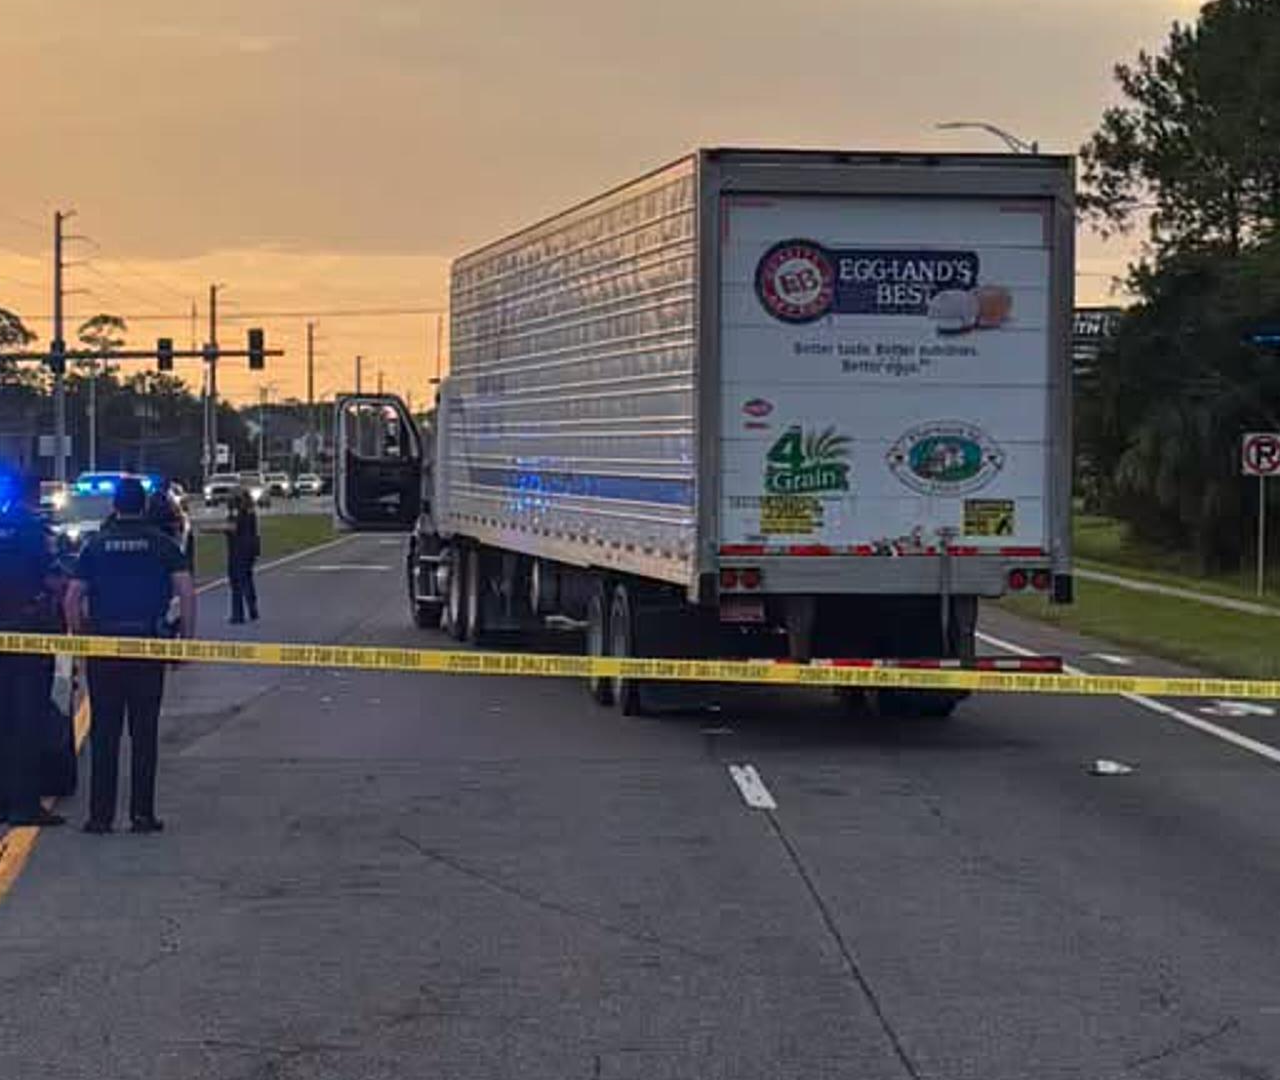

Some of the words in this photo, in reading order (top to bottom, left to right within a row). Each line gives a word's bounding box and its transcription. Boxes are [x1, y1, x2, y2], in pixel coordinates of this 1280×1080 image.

[877, 283, 937, 305] BEST
[765, 425, 805, 475] 4
[773, 469, 837, 491] Grain
